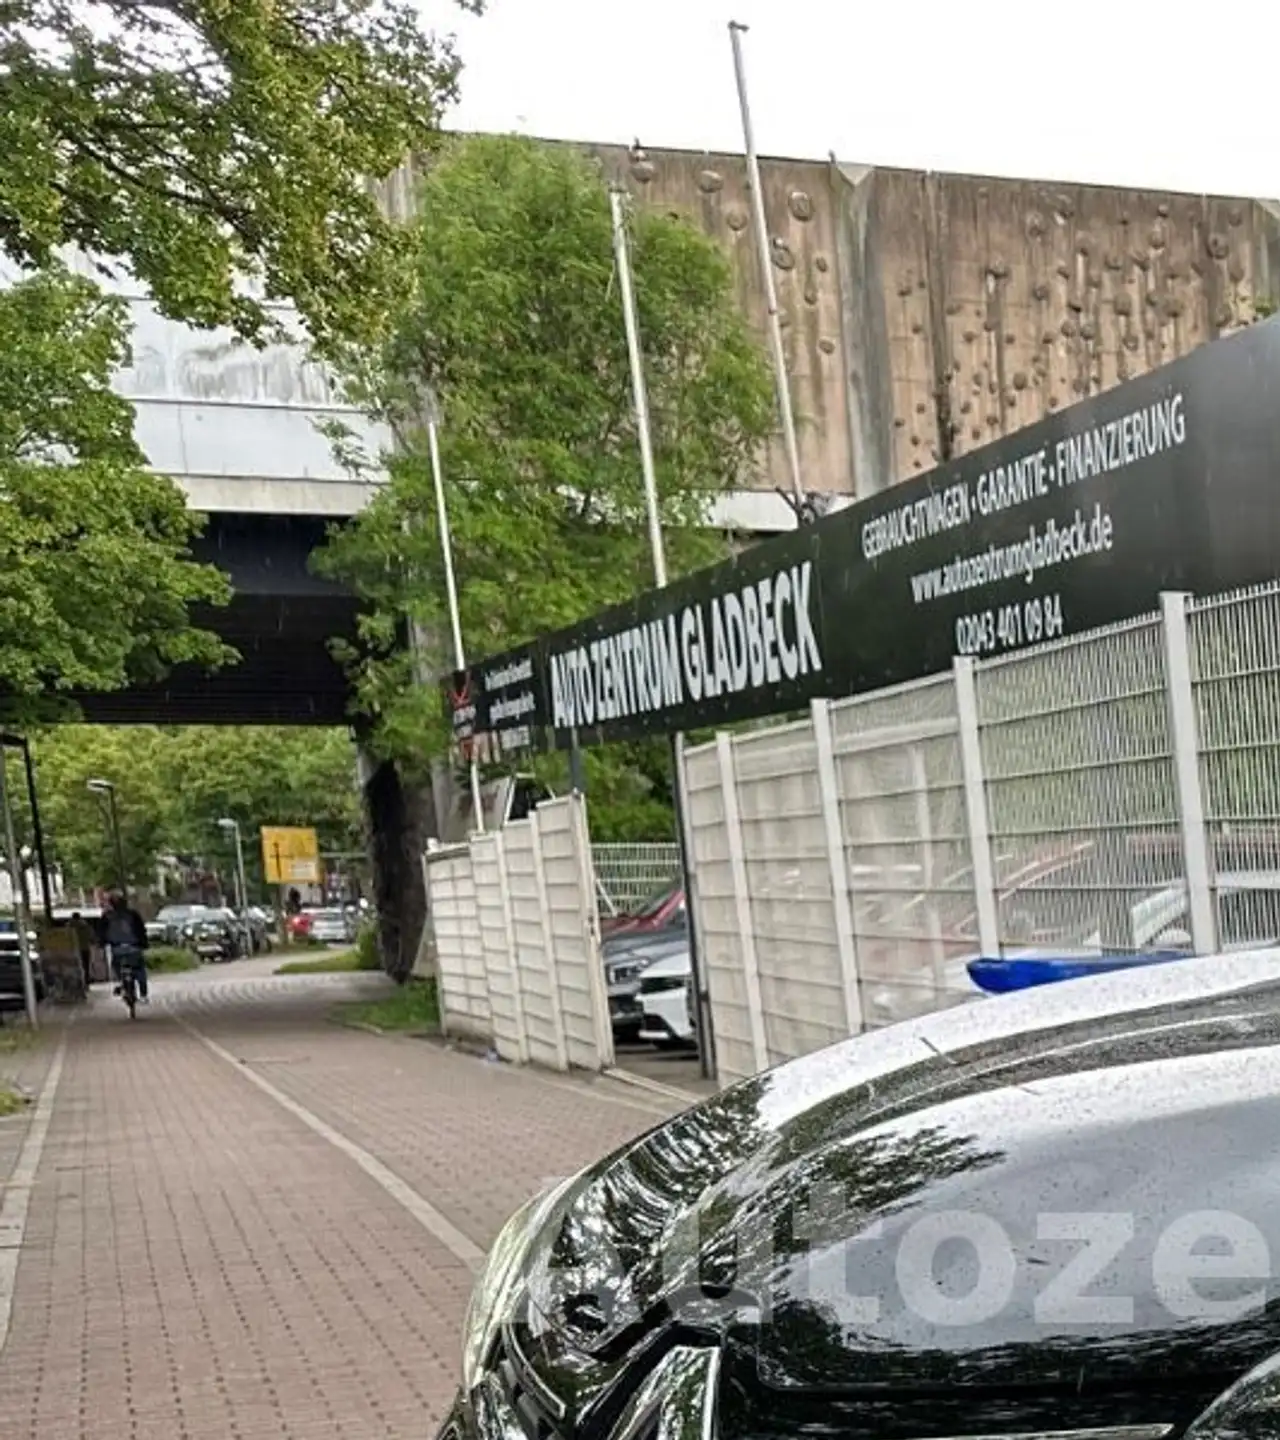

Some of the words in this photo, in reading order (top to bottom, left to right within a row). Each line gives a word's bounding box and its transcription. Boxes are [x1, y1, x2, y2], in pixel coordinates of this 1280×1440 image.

[861, 482, 970, 559] GEBRAUCHTWAGEN
[976, 450, 1048, 516] GARANTIE
[1055, 393, 1186, 487] FINANZIERUNG
[911, 503, 1113, 604] www.autozentrumgladbeck.de
[551, 645, 595, 728] AUTO
[590, 613, 683, 721] ZENTRUM
[681, 560, 822, 701] GLADBECK
[998, 603, 1024, 647] 401
[1024, 598, 1043, 642] 09
[1043, 594, 1063, 637] 84
